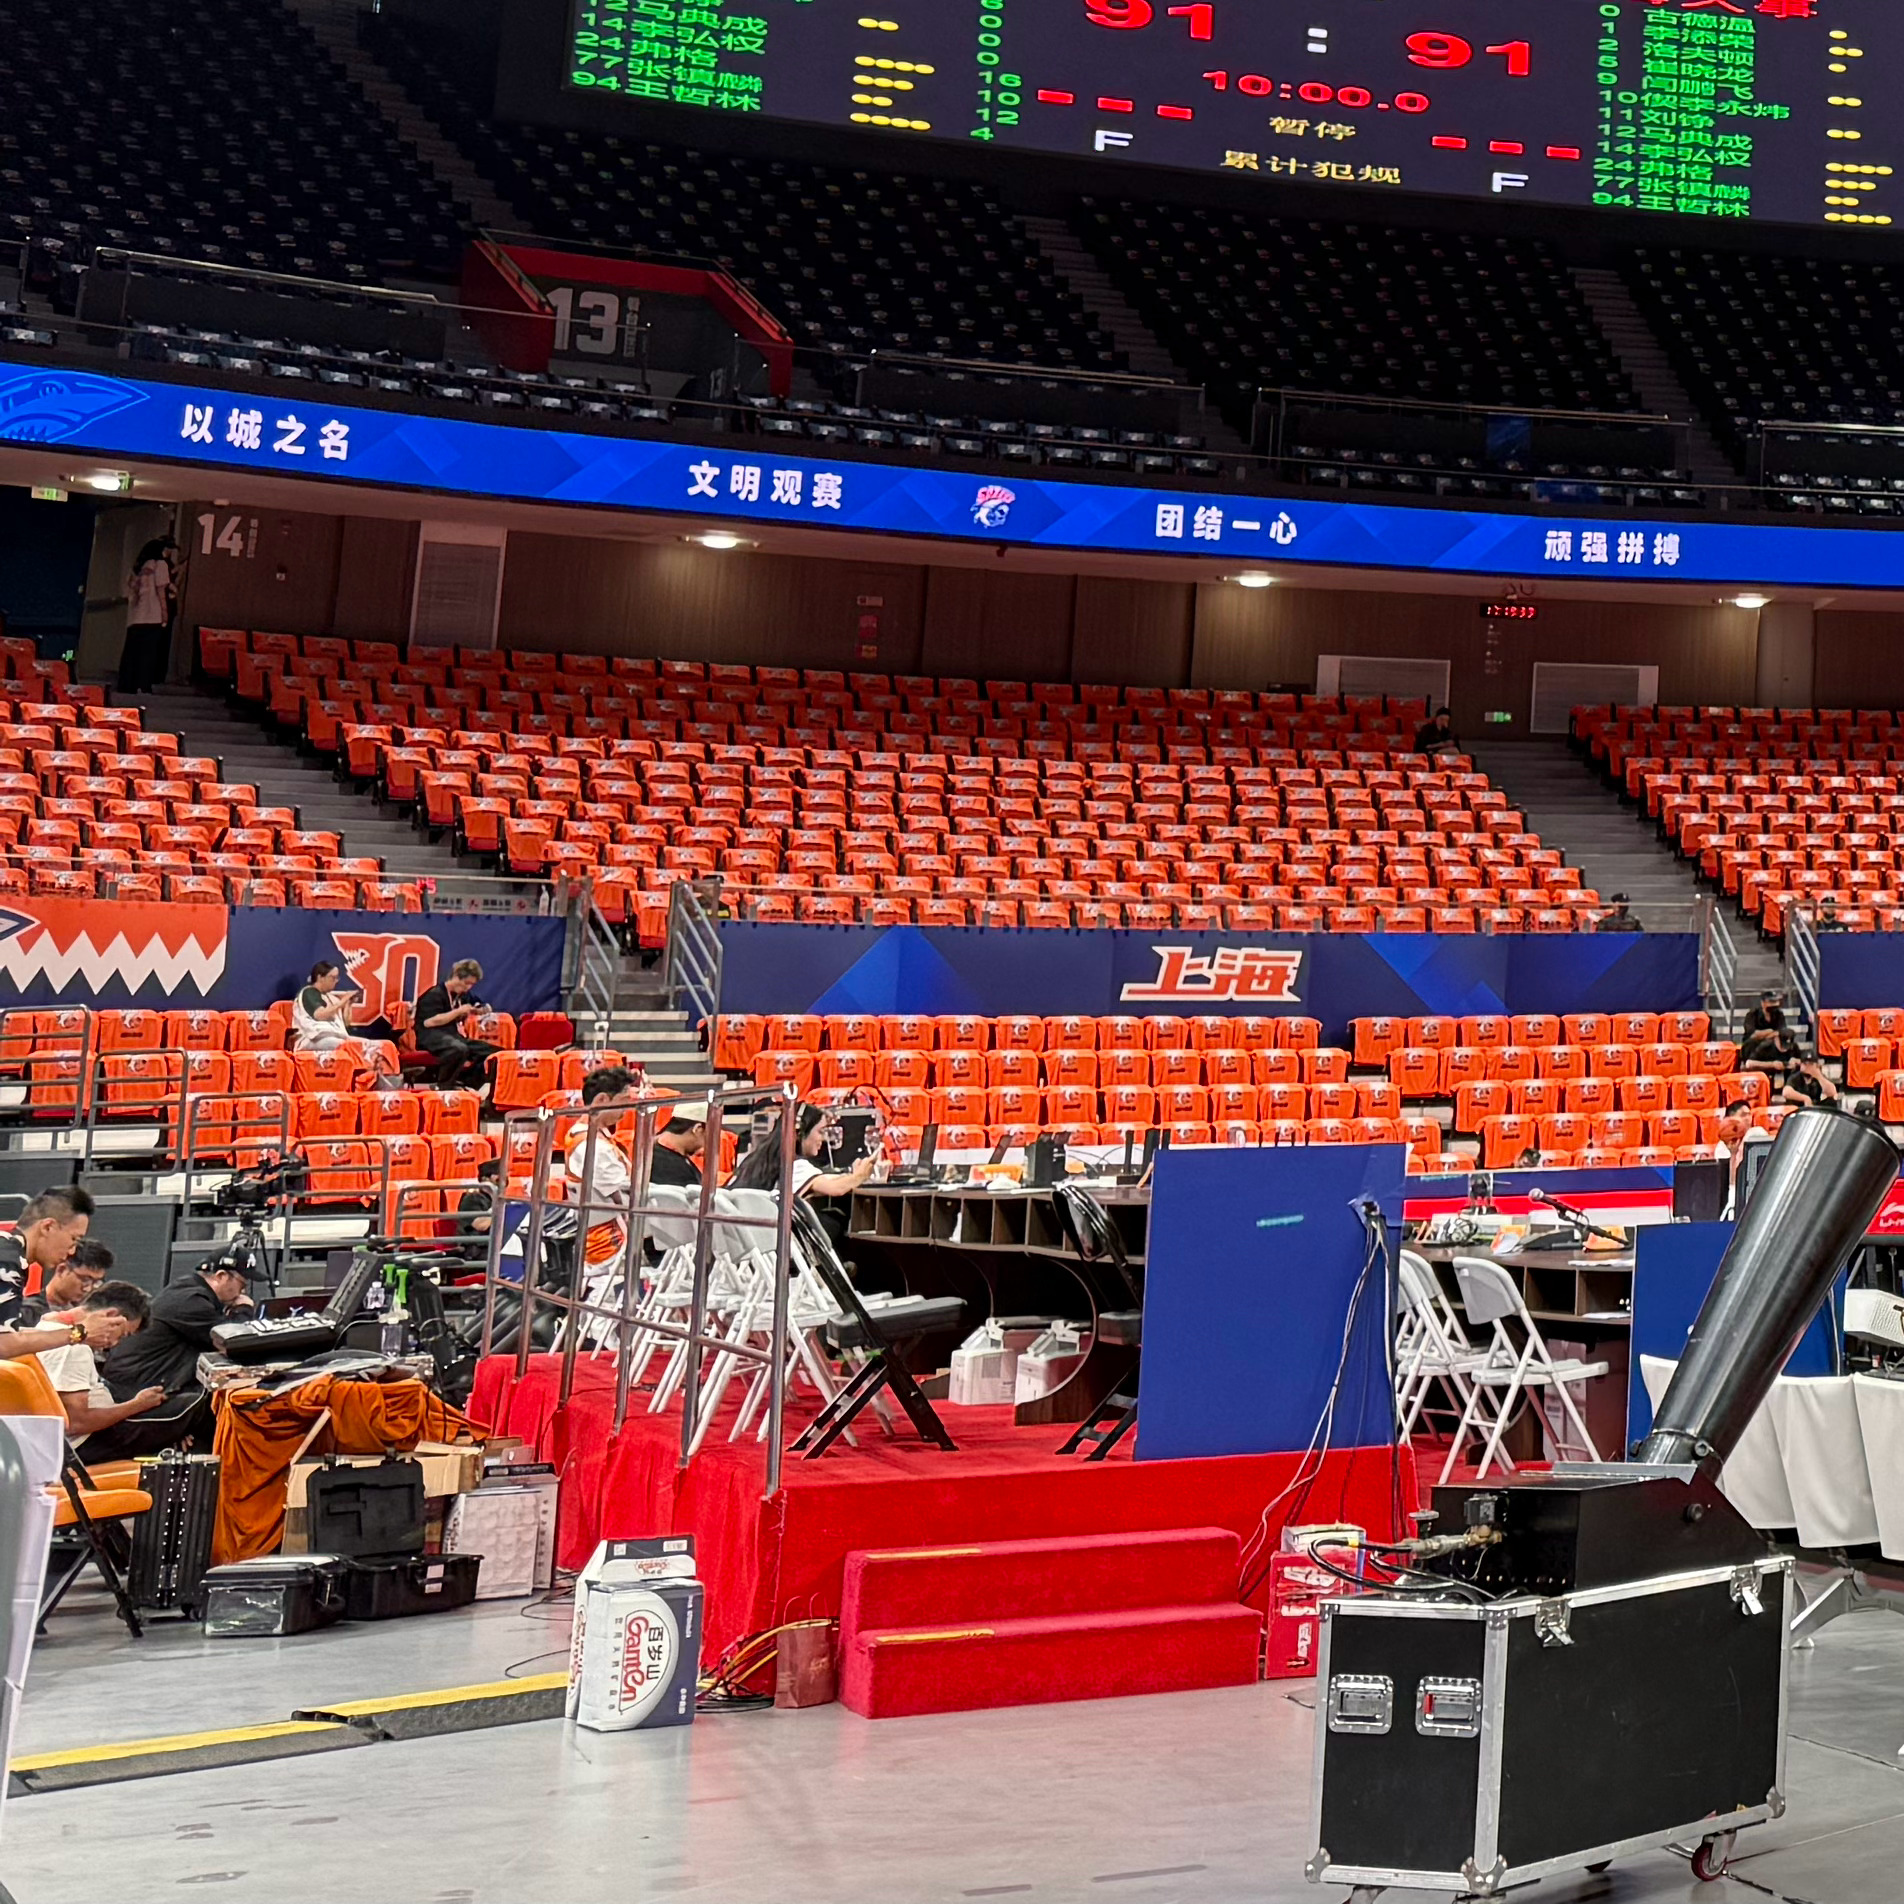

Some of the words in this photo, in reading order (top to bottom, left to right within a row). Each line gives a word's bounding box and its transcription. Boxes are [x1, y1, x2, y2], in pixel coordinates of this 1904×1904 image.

[632, 0, 768, 35] 马典成
[977, 52, 999, 65] 0
[980, 15, 1002, 28] 0
[1600, 5, 1620, 16] 0
[1644, 9, 1755, 33] 古德温
[1602, 22, 1614, 34] 1
[582, 13, 626, 31] 14
[980, 71, 1021, 87] 16
[978, 33, 1001, 46] 0
[1405, 31, 1530, 76] 91
[1598, 39, 1618, 51] 2
[1643, 42, 1754, 66] 洛夫顿
[576, 32, 624, 50] 24
[980, 90, 1020, 105] 10
[1597, 72, 1617, 84] 9
[1598, 55, 1618, 67] 5
[1642, 59, 1754, 83] 崔晓龙
[575, 50, 623, 69] 77
[976, 108, 1018, 125] 12
[1202, 70, 1430, 114] 10:00.0
[1600, 90, 1638, 103] 10
[572, 71, 621, 90] 94
[625, 78, 761, 111] 王哲林
[970, 127, 993, 140] 4
[1599, 107, 1632, 120] 11
[1640, 110, 1715, 128] 刘铮
[1094, 130, 1134, 152] F
[1269, 116, 1356, 141] 暂停
[1598, 124, 1636, 138] 12
[1639, 126, 1752, 150] 马典成
[1597, 141, 1635, 155] 14
[1219, 149, 1401, 185] 累计犯规
[1594, 158, 1635, 172] 24
[1594, 174, 1634, 188] 77
[1491, 171, 1529, 193] F
[1593, 192, 1634, 206] 94
[1637, 195, 1749, 216] 王哲林
[546, 287, 619, 355] 13
[181, 403, 350, 461] 以城之名
[687, 460, 843, 510] 文明观赛
[197, 512, 244, 558] 14
[1155, 503, 1297, 545] 团结一心
[1544, 530, 1681, 566] 顽强拼搏
[332, 931, 440, 1027] 30
[1120, 945, 1303, 1003] 上海
[646, 1626, 664, 1680] 百岁山
